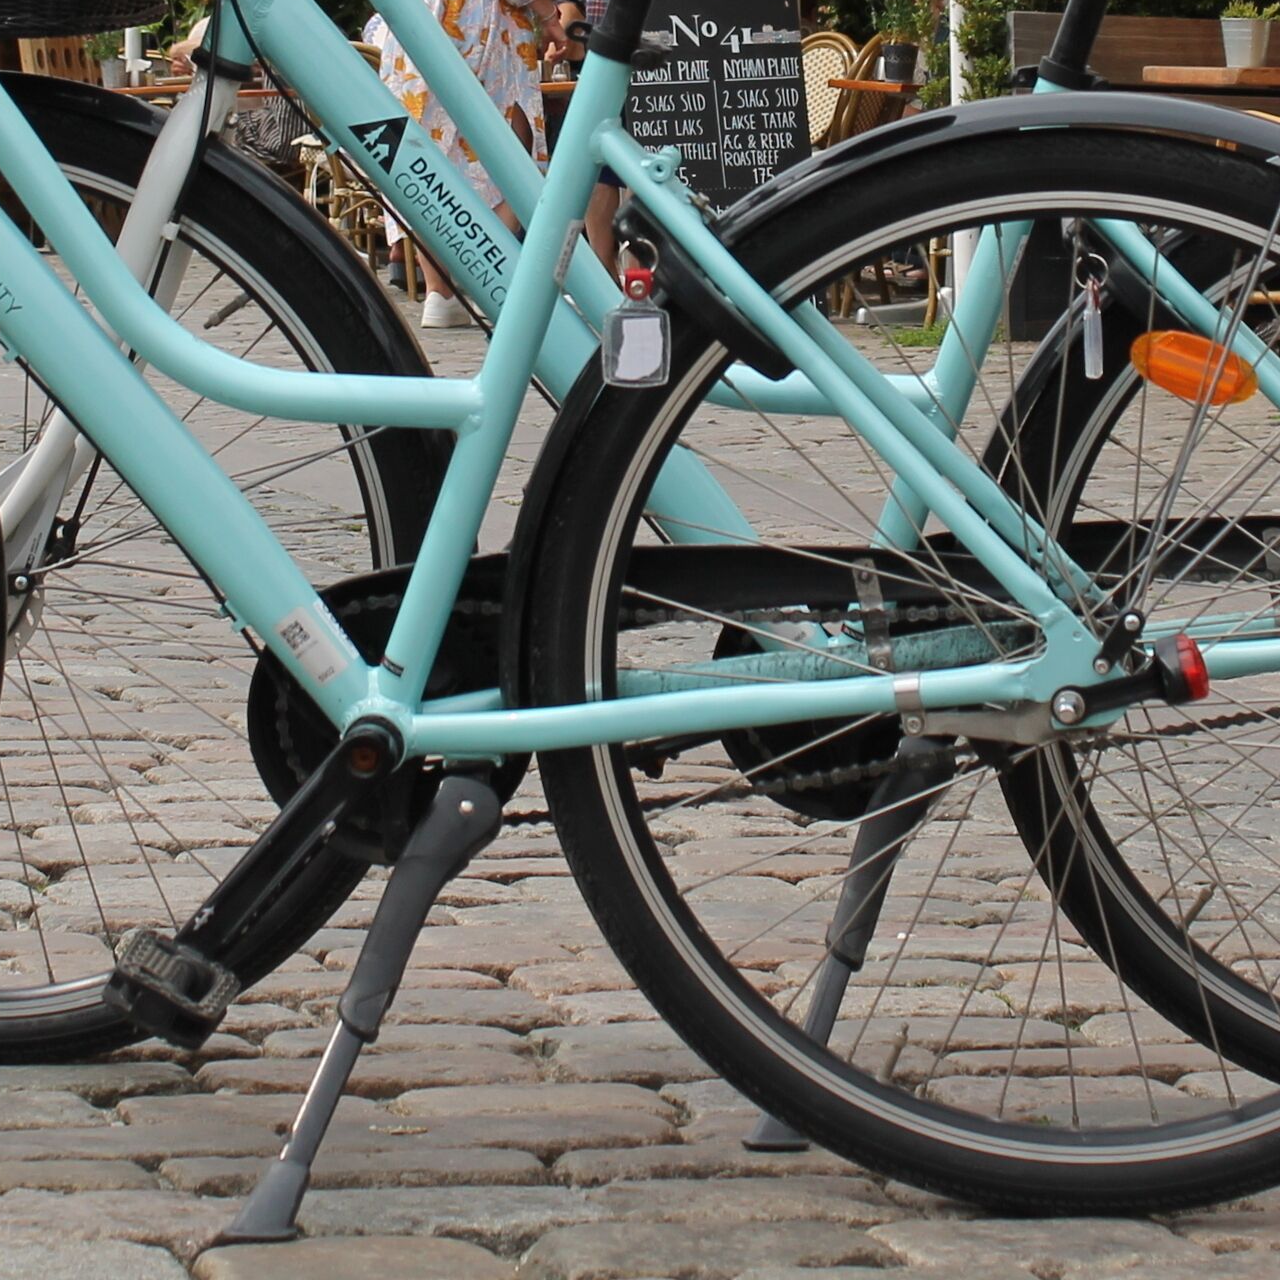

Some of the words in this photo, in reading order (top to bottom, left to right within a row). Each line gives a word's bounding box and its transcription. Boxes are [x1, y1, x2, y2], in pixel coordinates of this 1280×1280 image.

[677, 60, 710, 81] PLATTE
[767, 56, 800, 77] PLATTE
[631, 95, 643, 113] 2
[722, 89, 733, 109] 2
[632, 119, 668, 137] RØGET
[675, 118, 704, 136] LAKS
[723, 114, 757, 130] LAKSE
[761, 111, 798, 129] TATAR
[747, 134, 757, 149] &
[760, 132, 796, 149] REJER
[723, 150, 780, 167] ROASTBEEF
[409, 156, 511, 277] DANHOSTEL
[394, 172, 496, 288] COPENHAGEN
